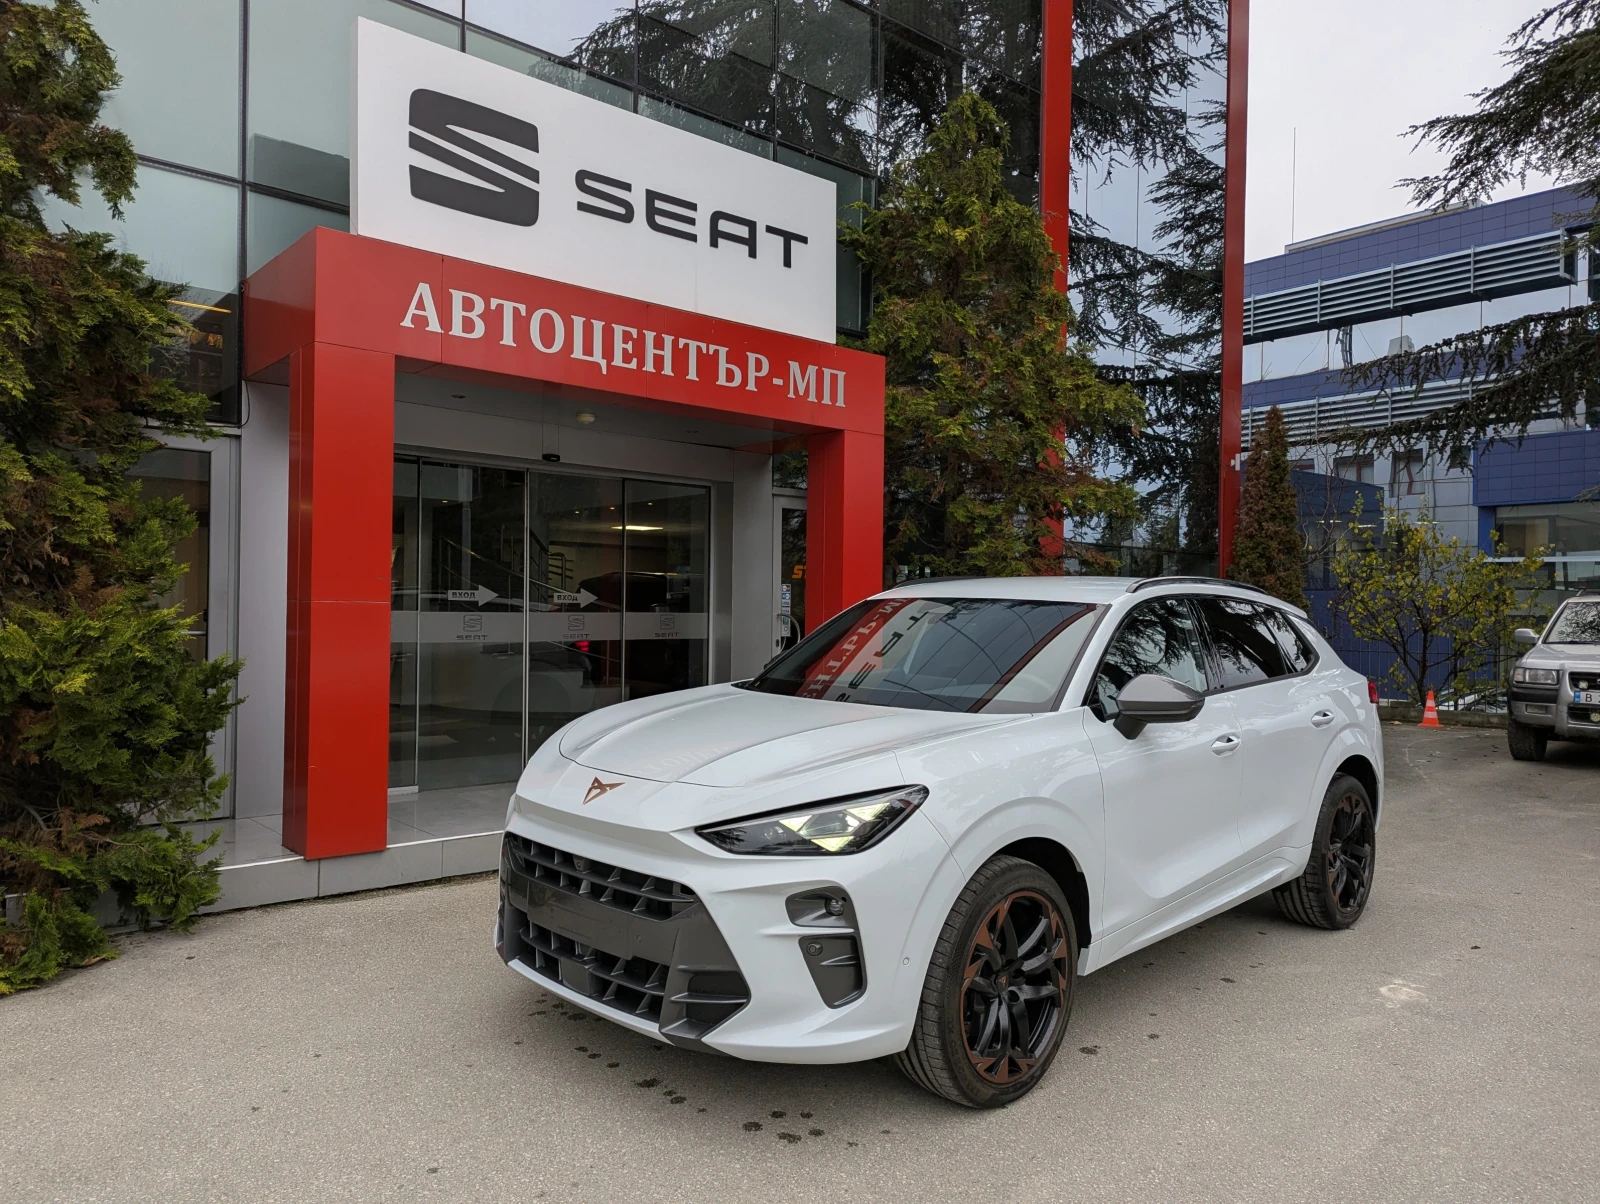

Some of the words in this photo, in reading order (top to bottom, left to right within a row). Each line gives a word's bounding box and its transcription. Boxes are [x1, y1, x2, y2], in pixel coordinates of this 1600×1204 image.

[575, 169, 808, 269] SEAT
[400, 282, 846, 408] АВТОЦЕНТЪР-МП
[451, 591, 476, 600] ВХОД
[556, 593, 579, 602] ВХОД
